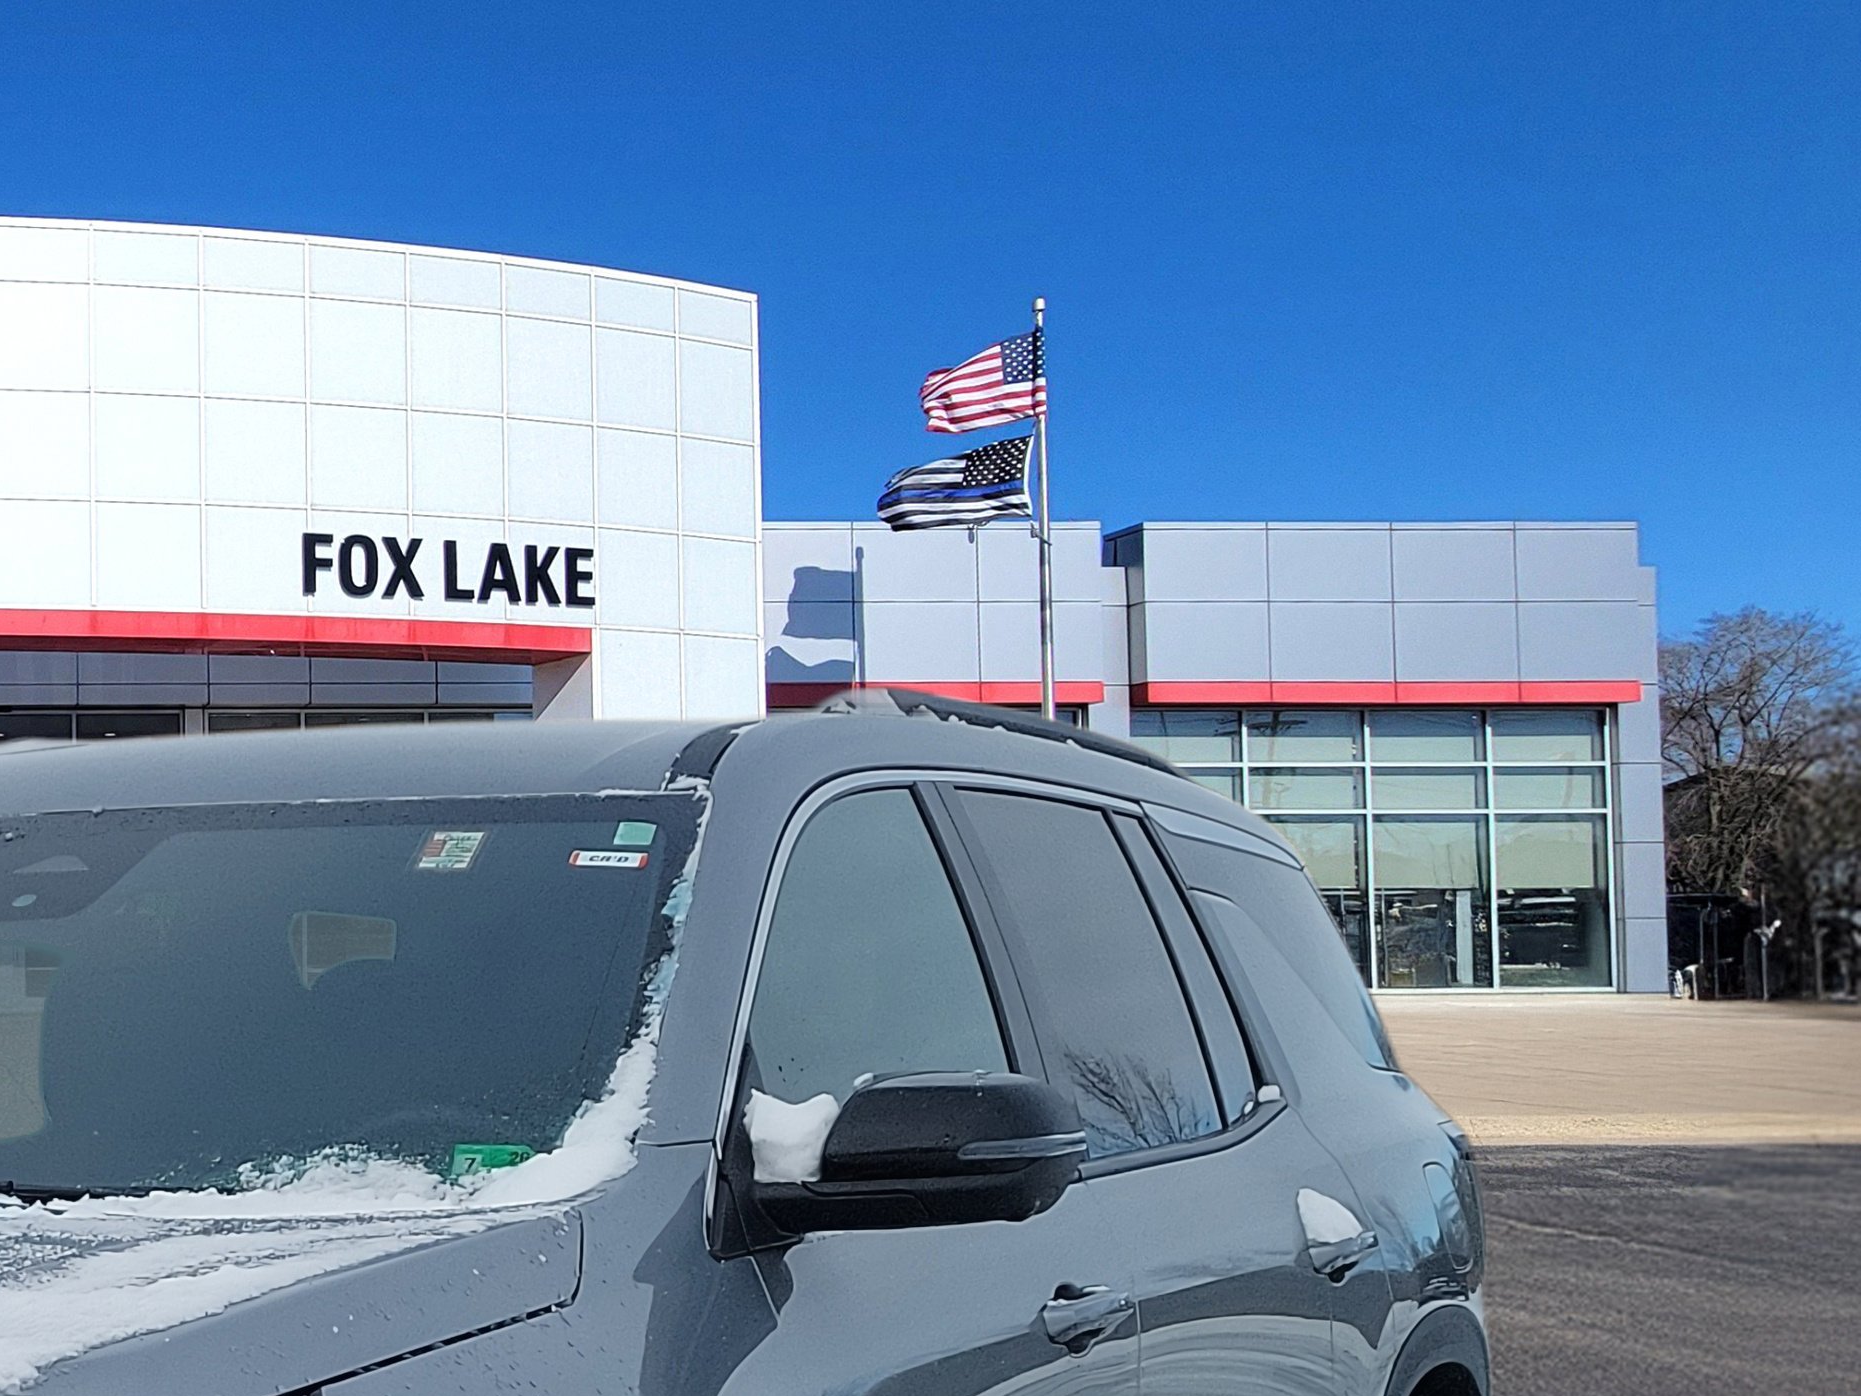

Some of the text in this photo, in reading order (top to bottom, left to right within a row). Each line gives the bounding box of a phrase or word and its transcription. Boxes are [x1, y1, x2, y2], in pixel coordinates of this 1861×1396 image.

[301, 532, 596, 608] FOX LAKE
[464, 1157, 477, 1173] 7
